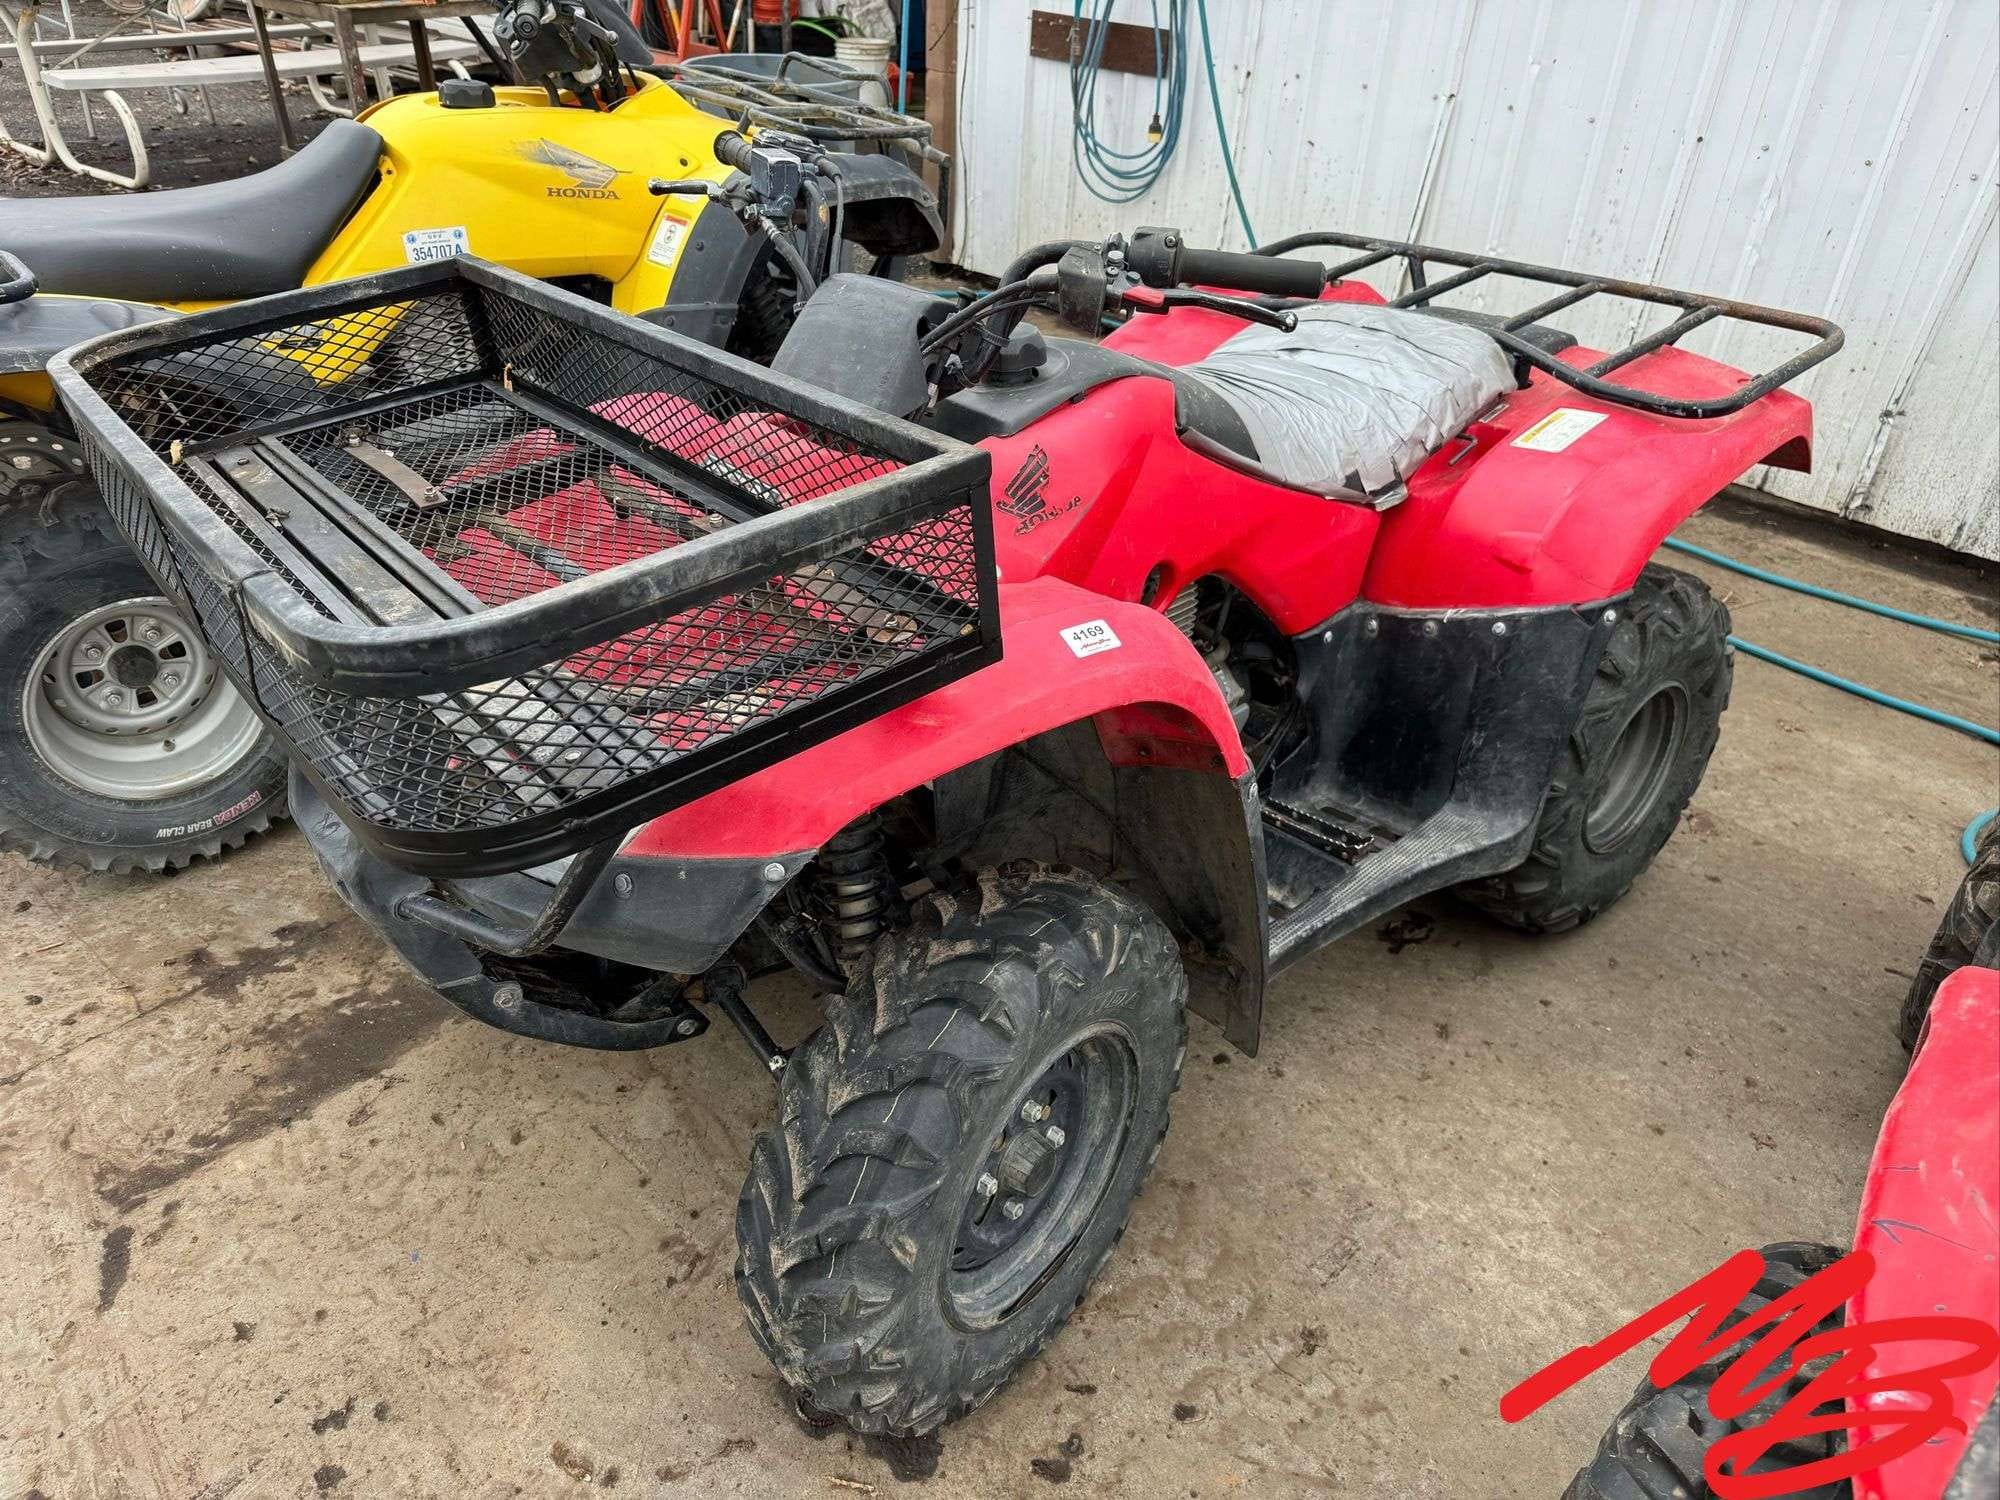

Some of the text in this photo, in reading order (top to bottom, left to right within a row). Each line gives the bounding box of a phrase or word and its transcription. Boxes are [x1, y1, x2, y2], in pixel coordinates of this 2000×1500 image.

[546, 187, 620, 199] HONDA
[1073, 625, 1104, 640] 4169
[155, 790, 262, 839] KENDA BEAR CLAW
